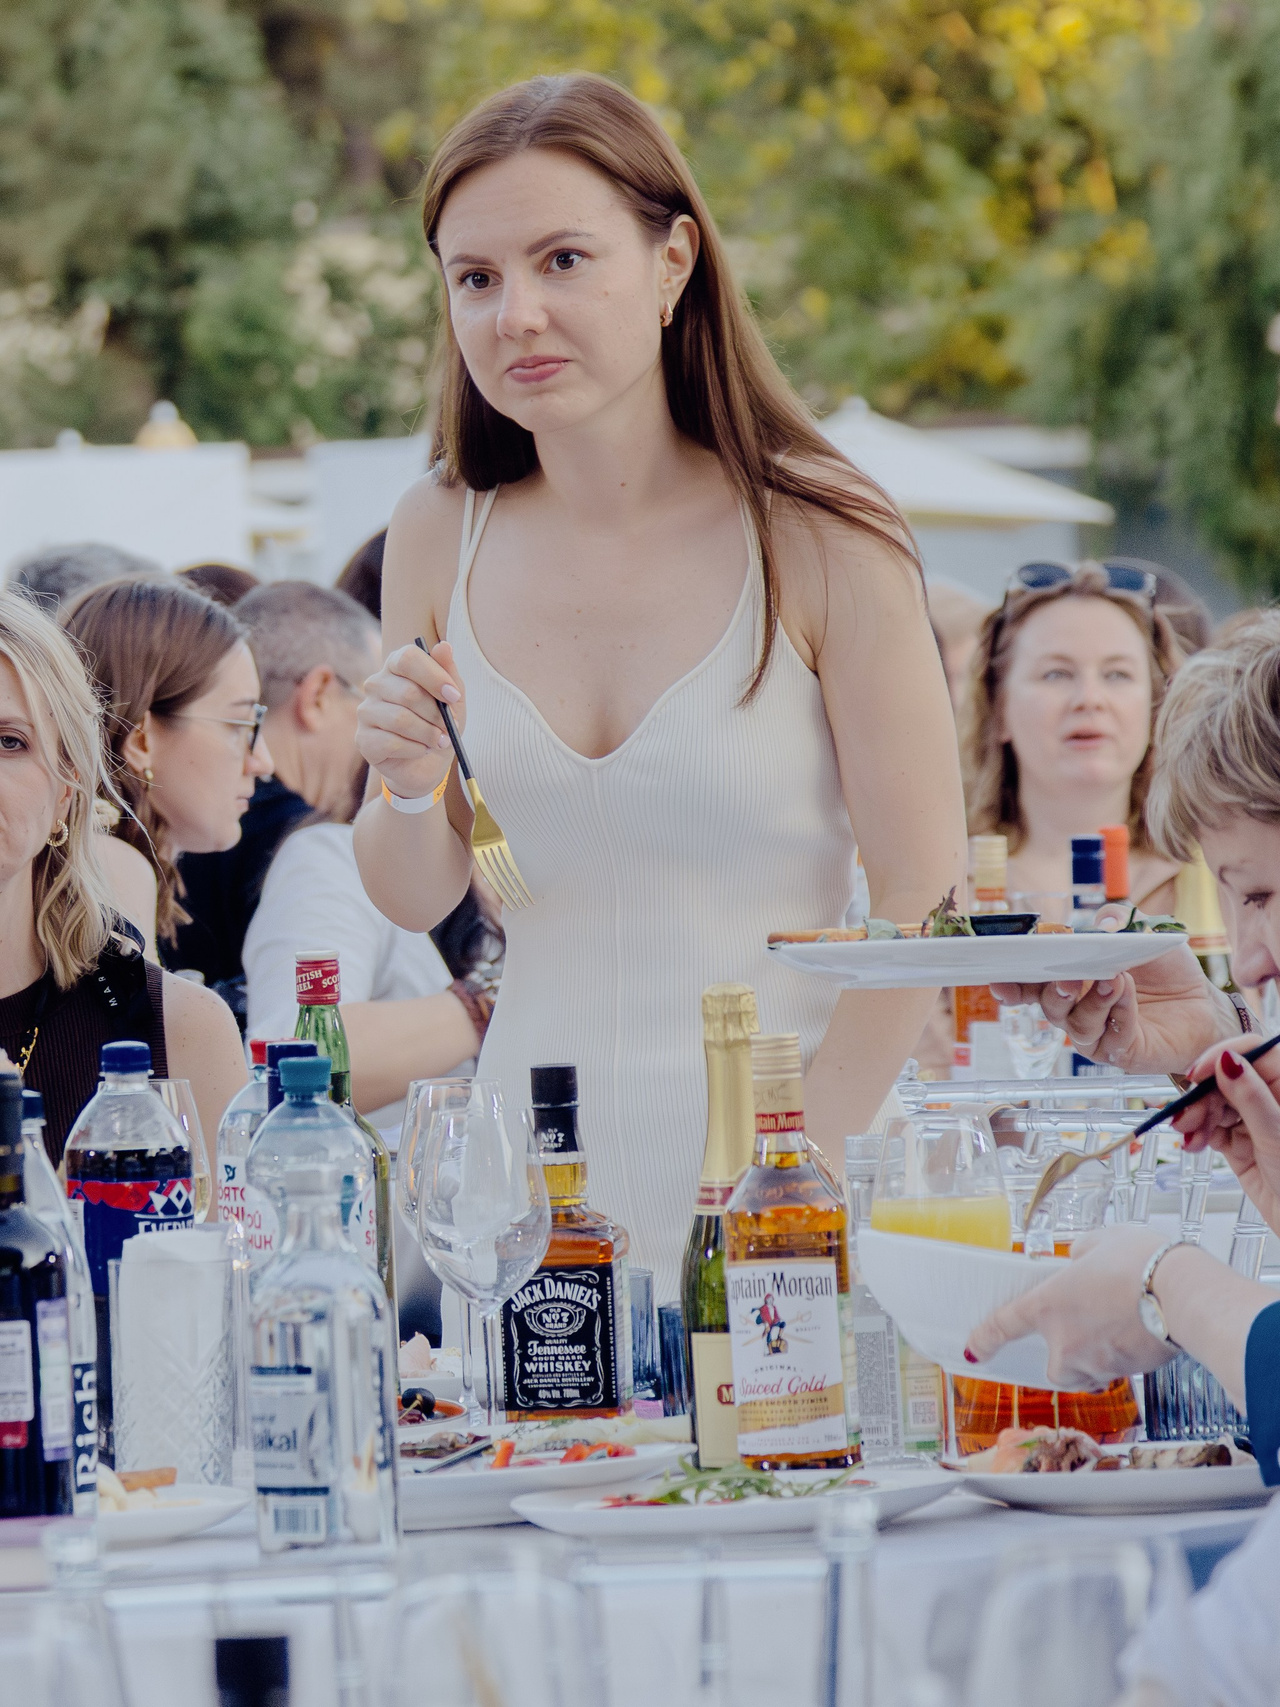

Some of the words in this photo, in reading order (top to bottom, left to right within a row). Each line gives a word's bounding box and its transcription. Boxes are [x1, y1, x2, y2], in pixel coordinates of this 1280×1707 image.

[510, 1283, 546, 1314] JACK
[544, 1277, 602, 1313] DANIEL'S
[770, 1272, 833, 1302] Morgan
[527, 1340, 587, 1356] Tennessee
[523, 1360, 592, 1374] WHISKEY
[740, 1376, 783, 1398] Spiced
[787, 1374, 828, 1397] Gold
